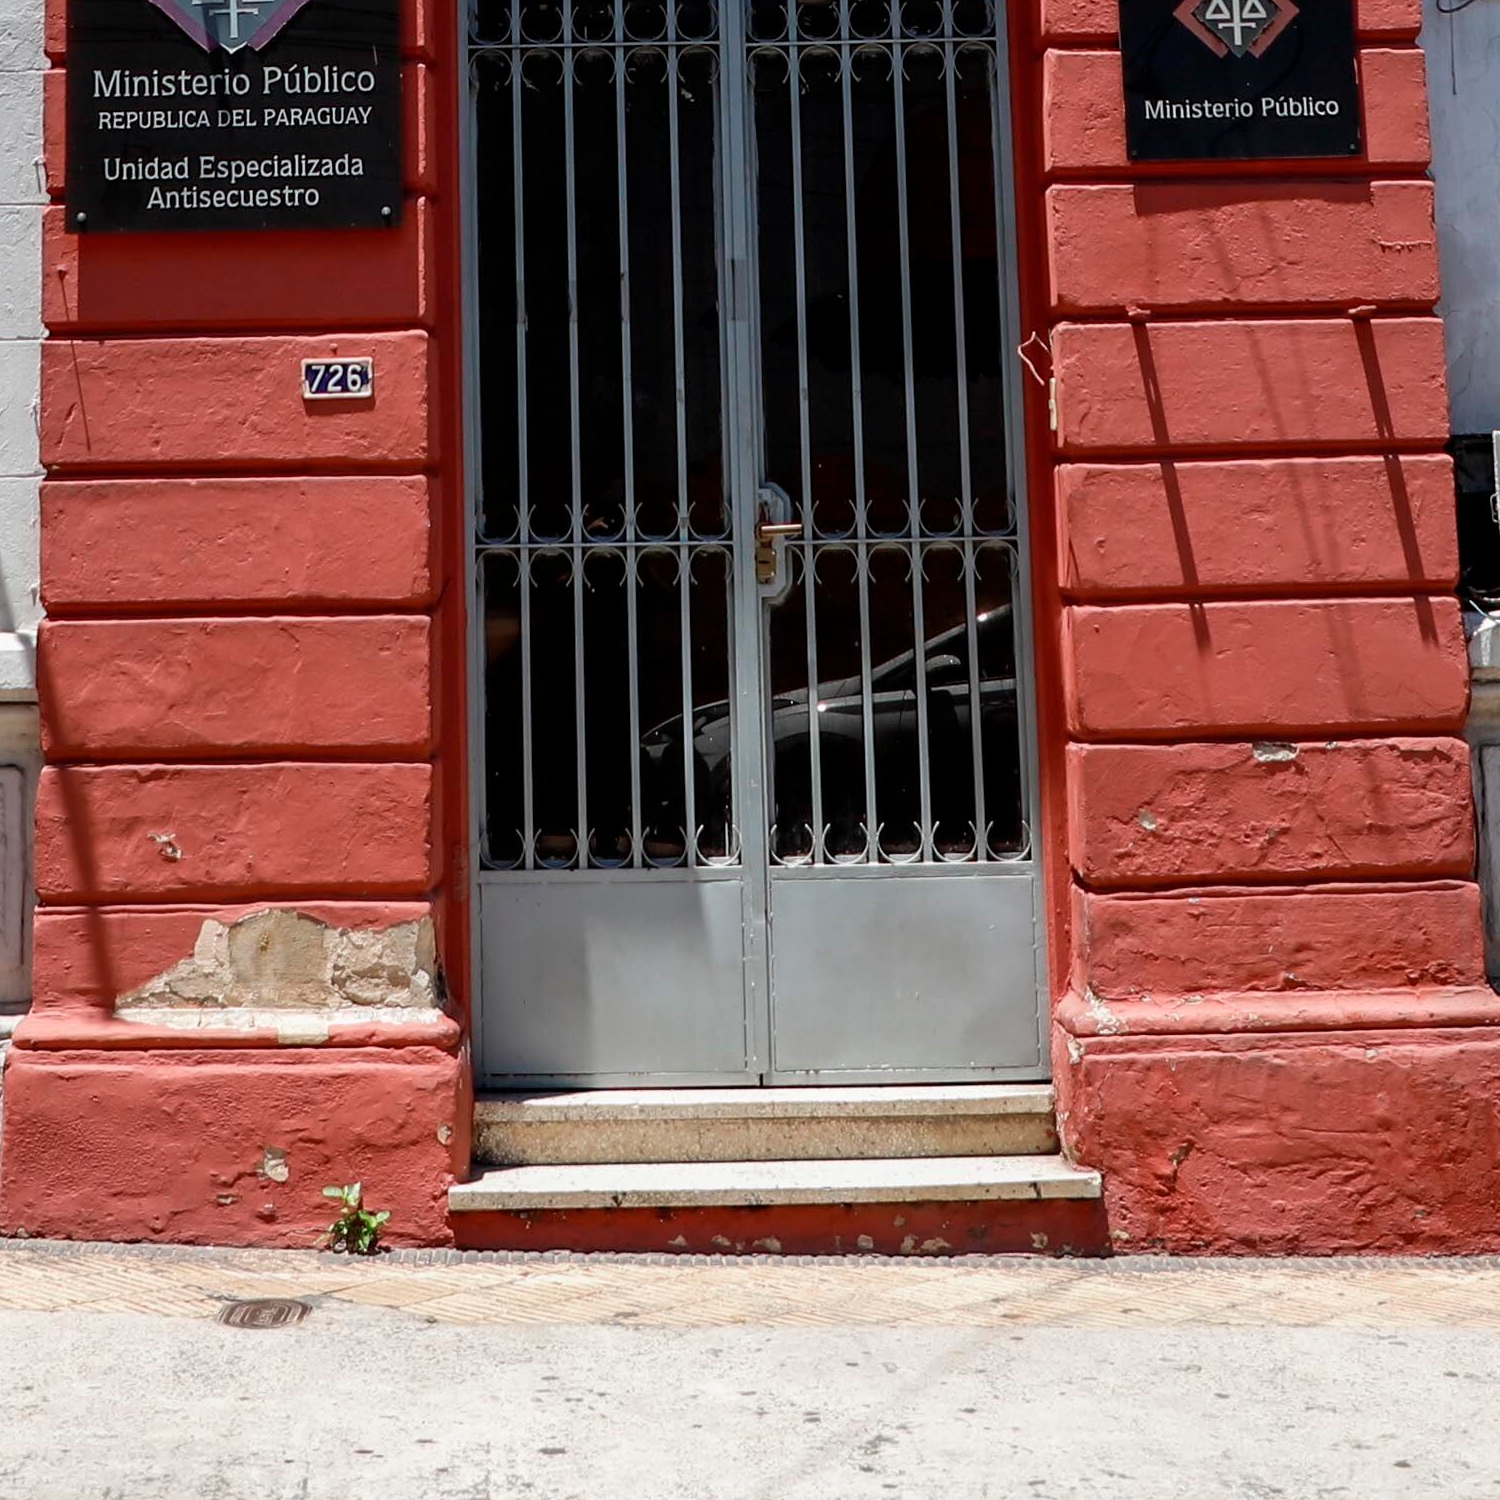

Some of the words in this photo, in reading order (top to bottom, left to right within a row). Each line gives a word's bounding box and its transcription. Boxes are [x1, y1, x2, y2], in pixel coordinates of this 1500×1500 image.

[94, 68, 249, 97] Ministerio
[263, 63, 375, 95] Público
[98, 109, 211, 130] REPUBLICA
[217, 108, 256, 128] DEL
[263, 106, 373, 127] PARAGUAY
[1145, 98, 1253, 120] Ministerio
[1262, 95, 1340, 117] Público
[103, 156, 189, 181] Unidad
[200, 153, 364, 183] Especializada
[147, 185, 320, 209] Antisecuestro
[311, 363, 361, 393] 726
